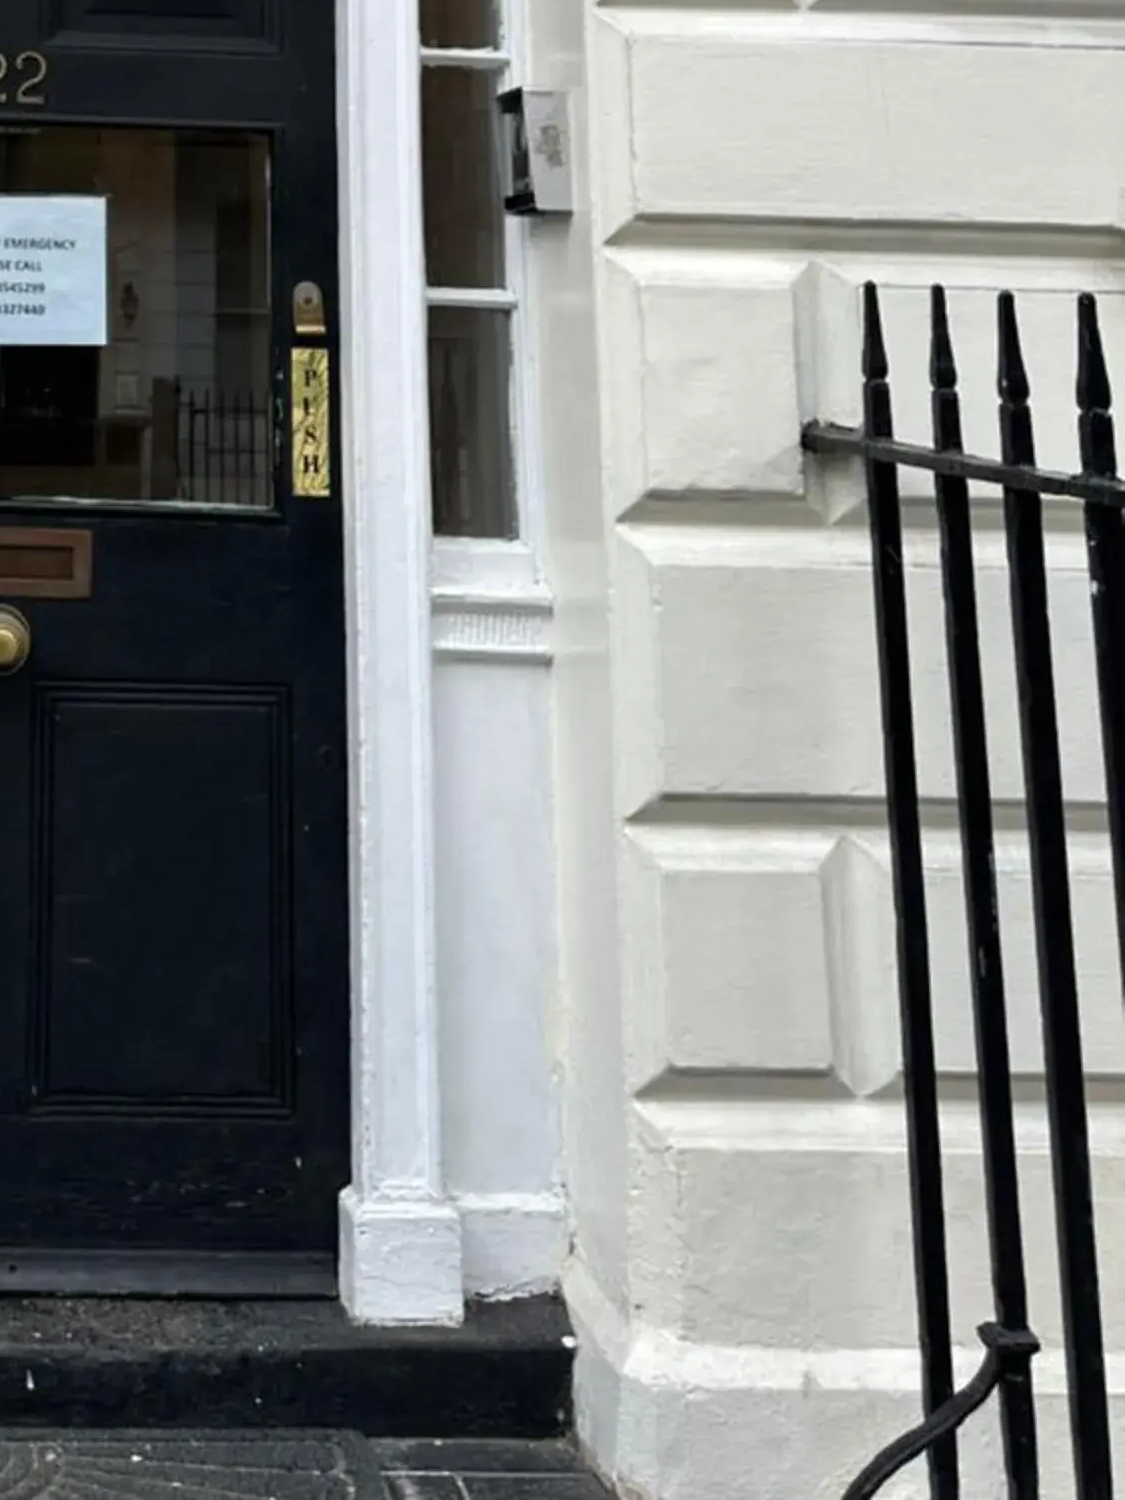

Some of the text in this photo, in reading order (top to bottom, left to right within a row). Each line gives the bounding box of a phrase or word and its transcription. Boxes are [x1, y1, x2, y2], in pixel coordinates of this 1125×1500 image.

[3, 237, 77, 250] EMERGENCY
[14, 260, 43, 272] CALL
[302, 369, 320, 474] PUSH
